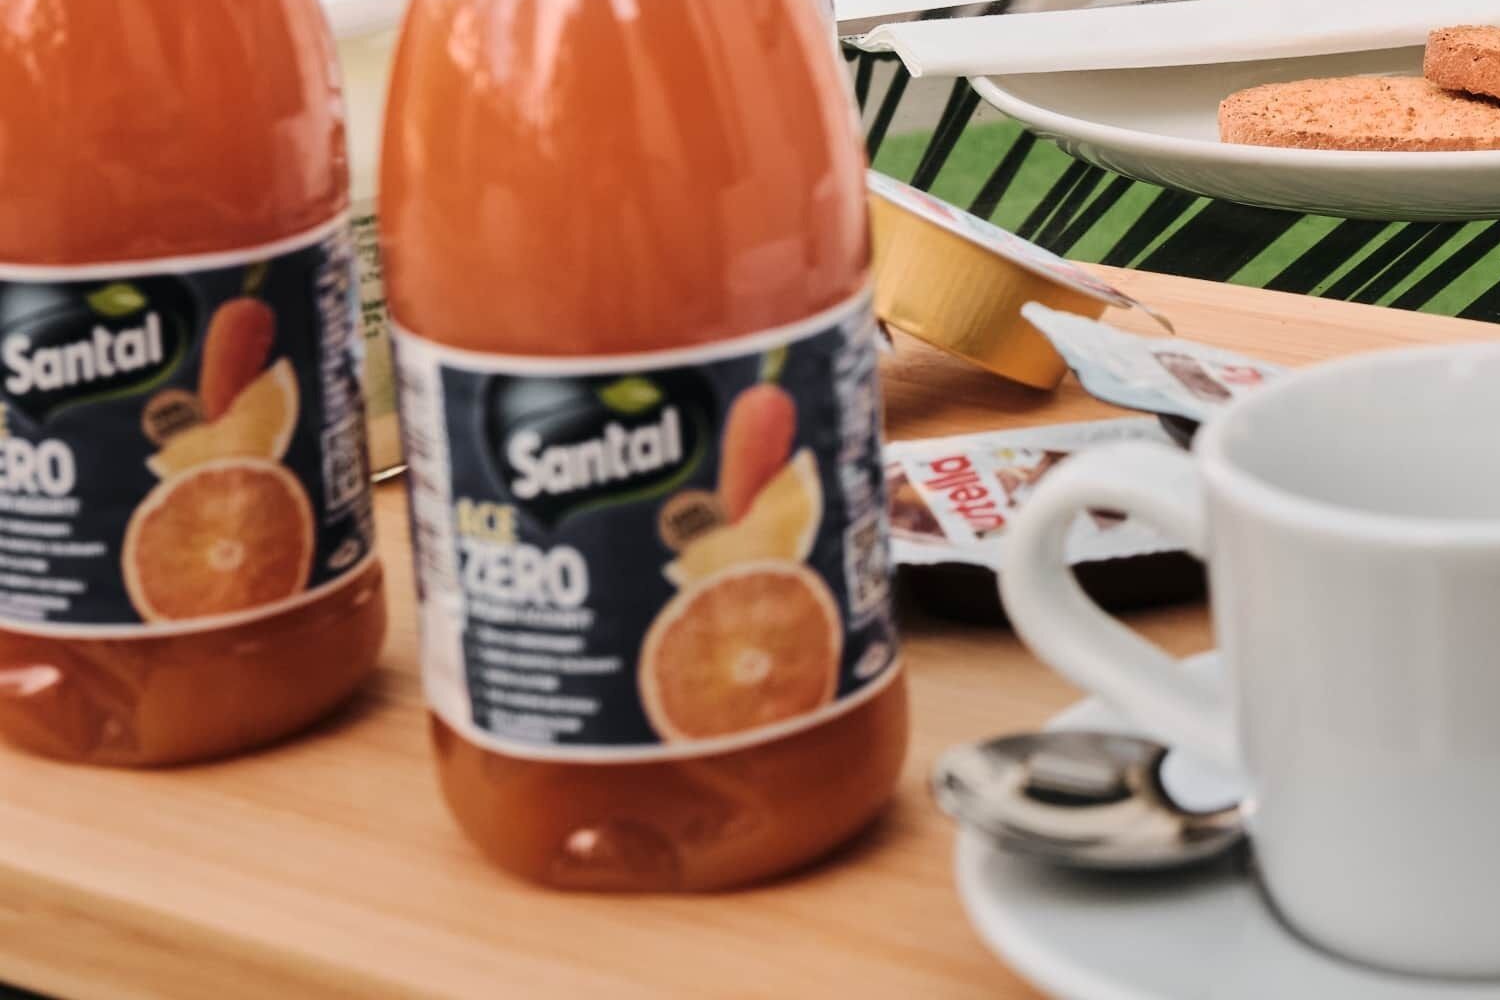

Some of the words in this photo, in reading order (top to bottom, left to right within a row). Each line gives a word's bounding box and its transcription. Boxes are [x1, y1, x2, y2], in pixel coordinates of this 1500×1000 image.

[2, 313, 163, 394] Santal
[0, 436, 77, 497] ERO
[506, 406, 684, 499] Santal
[924, 454, 1007, 538] utella
[458, 538, 591, 607] ZERO
